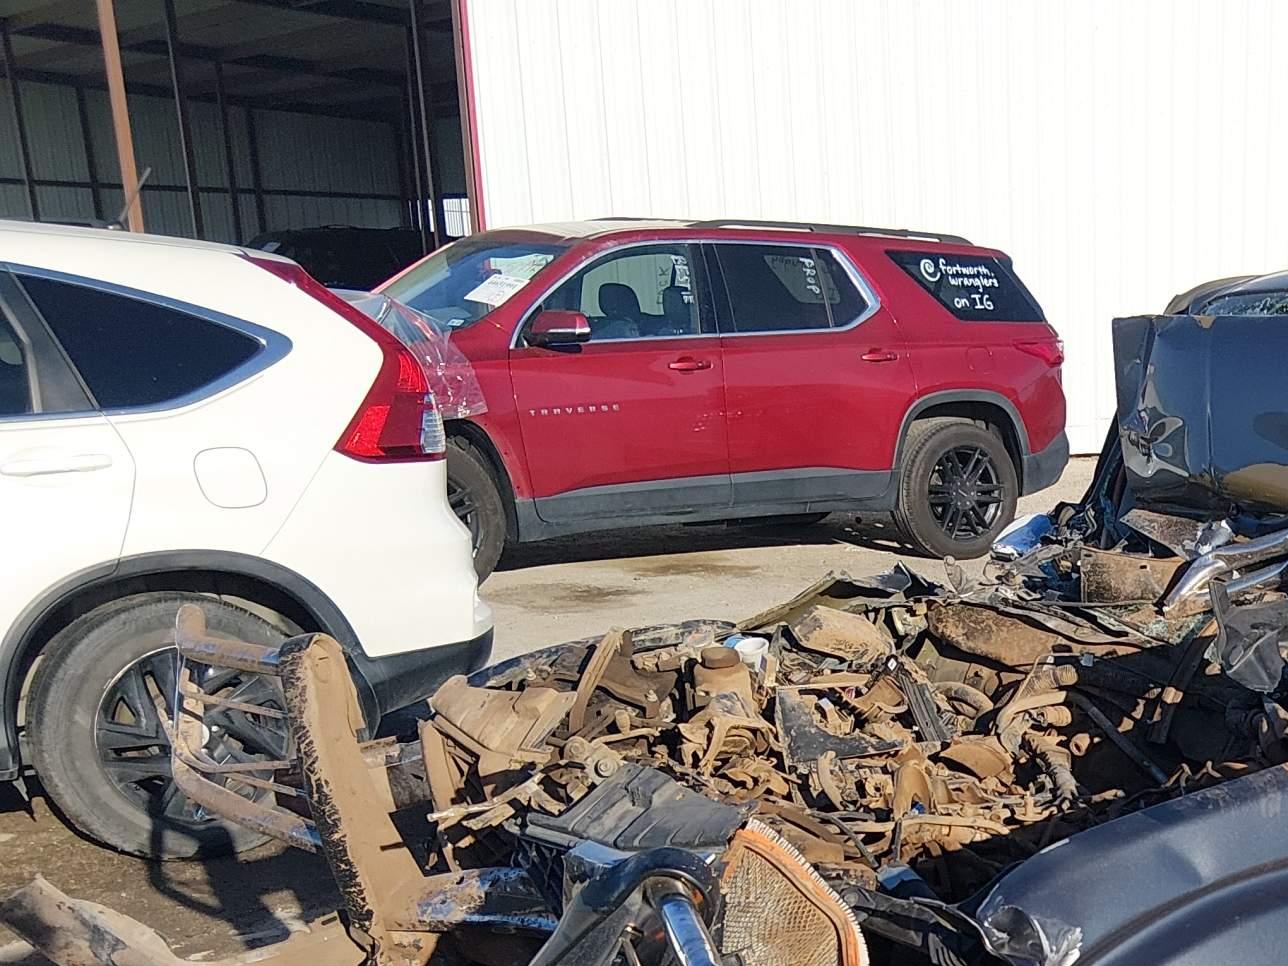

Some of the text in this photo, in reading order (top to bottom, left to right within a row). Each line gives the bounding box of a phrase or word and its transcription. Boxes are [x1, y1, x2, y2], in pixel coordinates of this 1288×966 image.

[670, 255, 695, 304] BESTIE
[948, 276, 999, 293] wranglers
[954, 294, 994, 310] on IG
[529, 403, 621, 417] TRAVERSE
